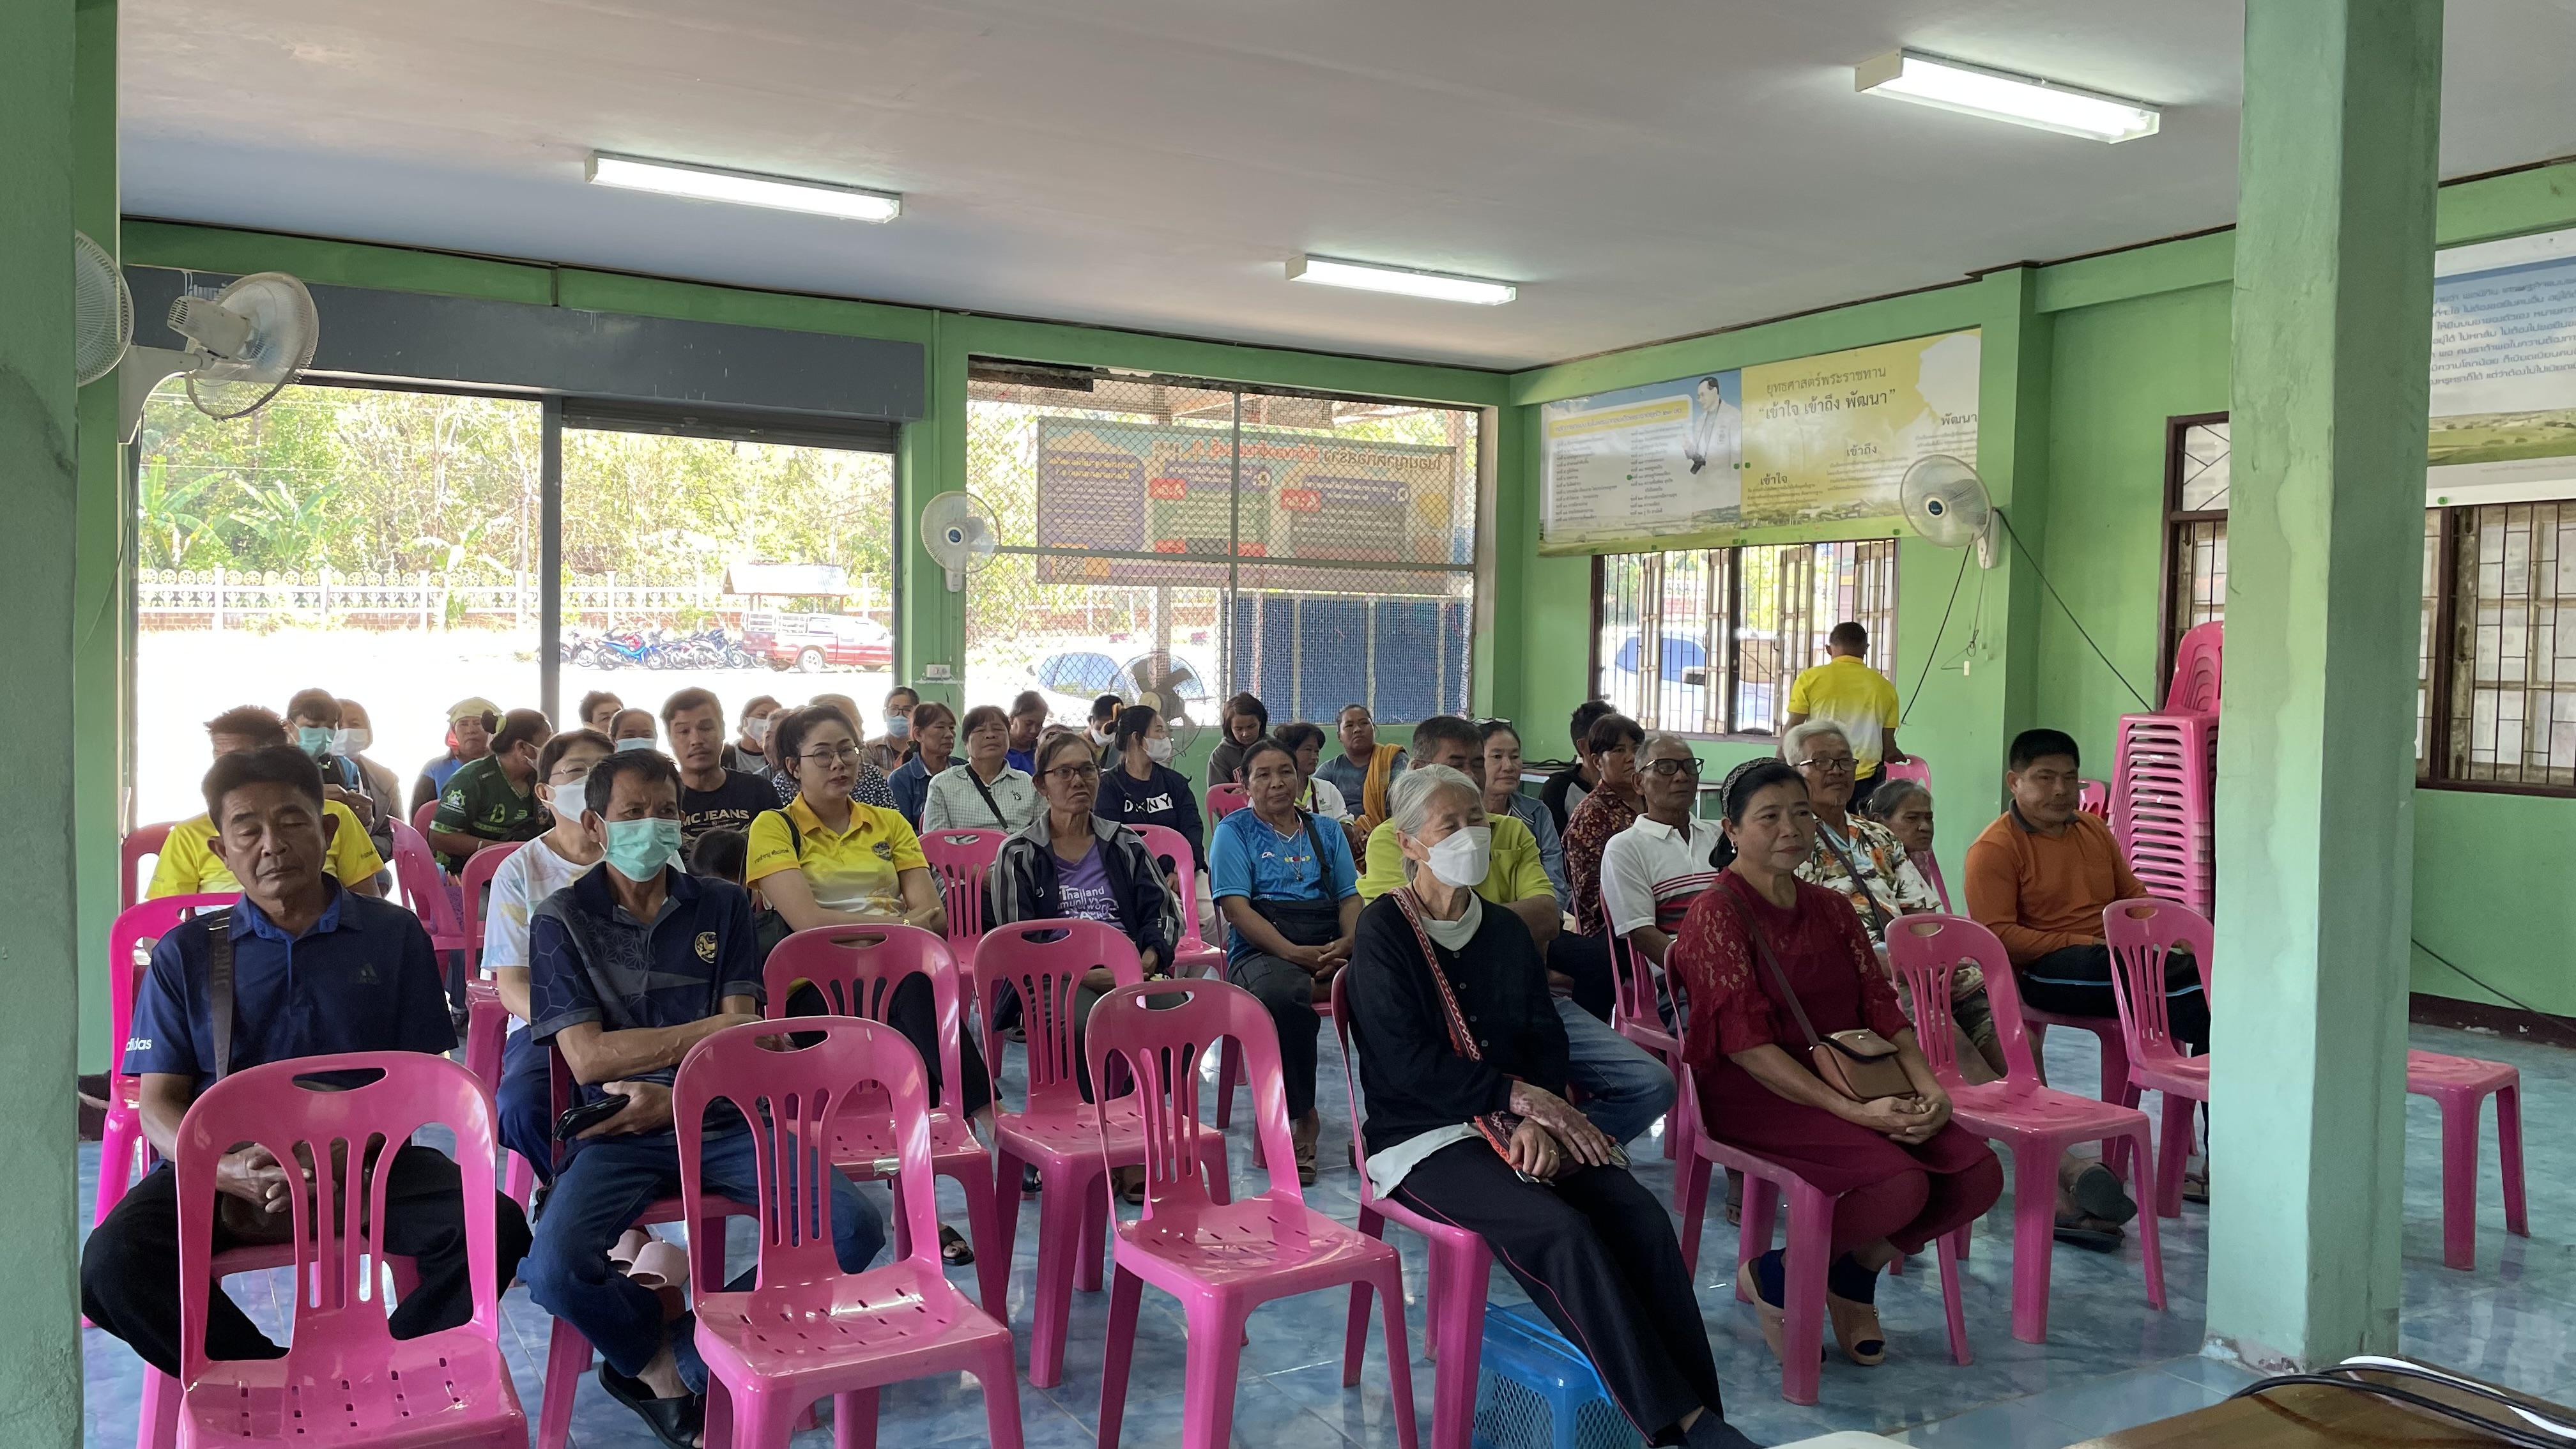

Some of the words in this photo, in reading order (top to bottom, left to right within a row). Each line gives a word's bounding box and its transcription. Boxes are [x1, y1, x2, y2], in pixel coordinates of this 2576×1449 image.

[1767, 367, 1887, 397] ยุทธศาสตร์พระราชทาน
[1804, 394, 1841, 414] เข้าถึง
[1942, 413, 1978, 426] พัฒนา
[1846, 443, 1878, 457] เข้าถึง
[1761, 472, 1788, 486] เข้าใจ
[1124, 793, 1170, 813] DKNY
[703, 808, 750, 822] JEANS
[1059, 884, 1105, 901] Thailand
